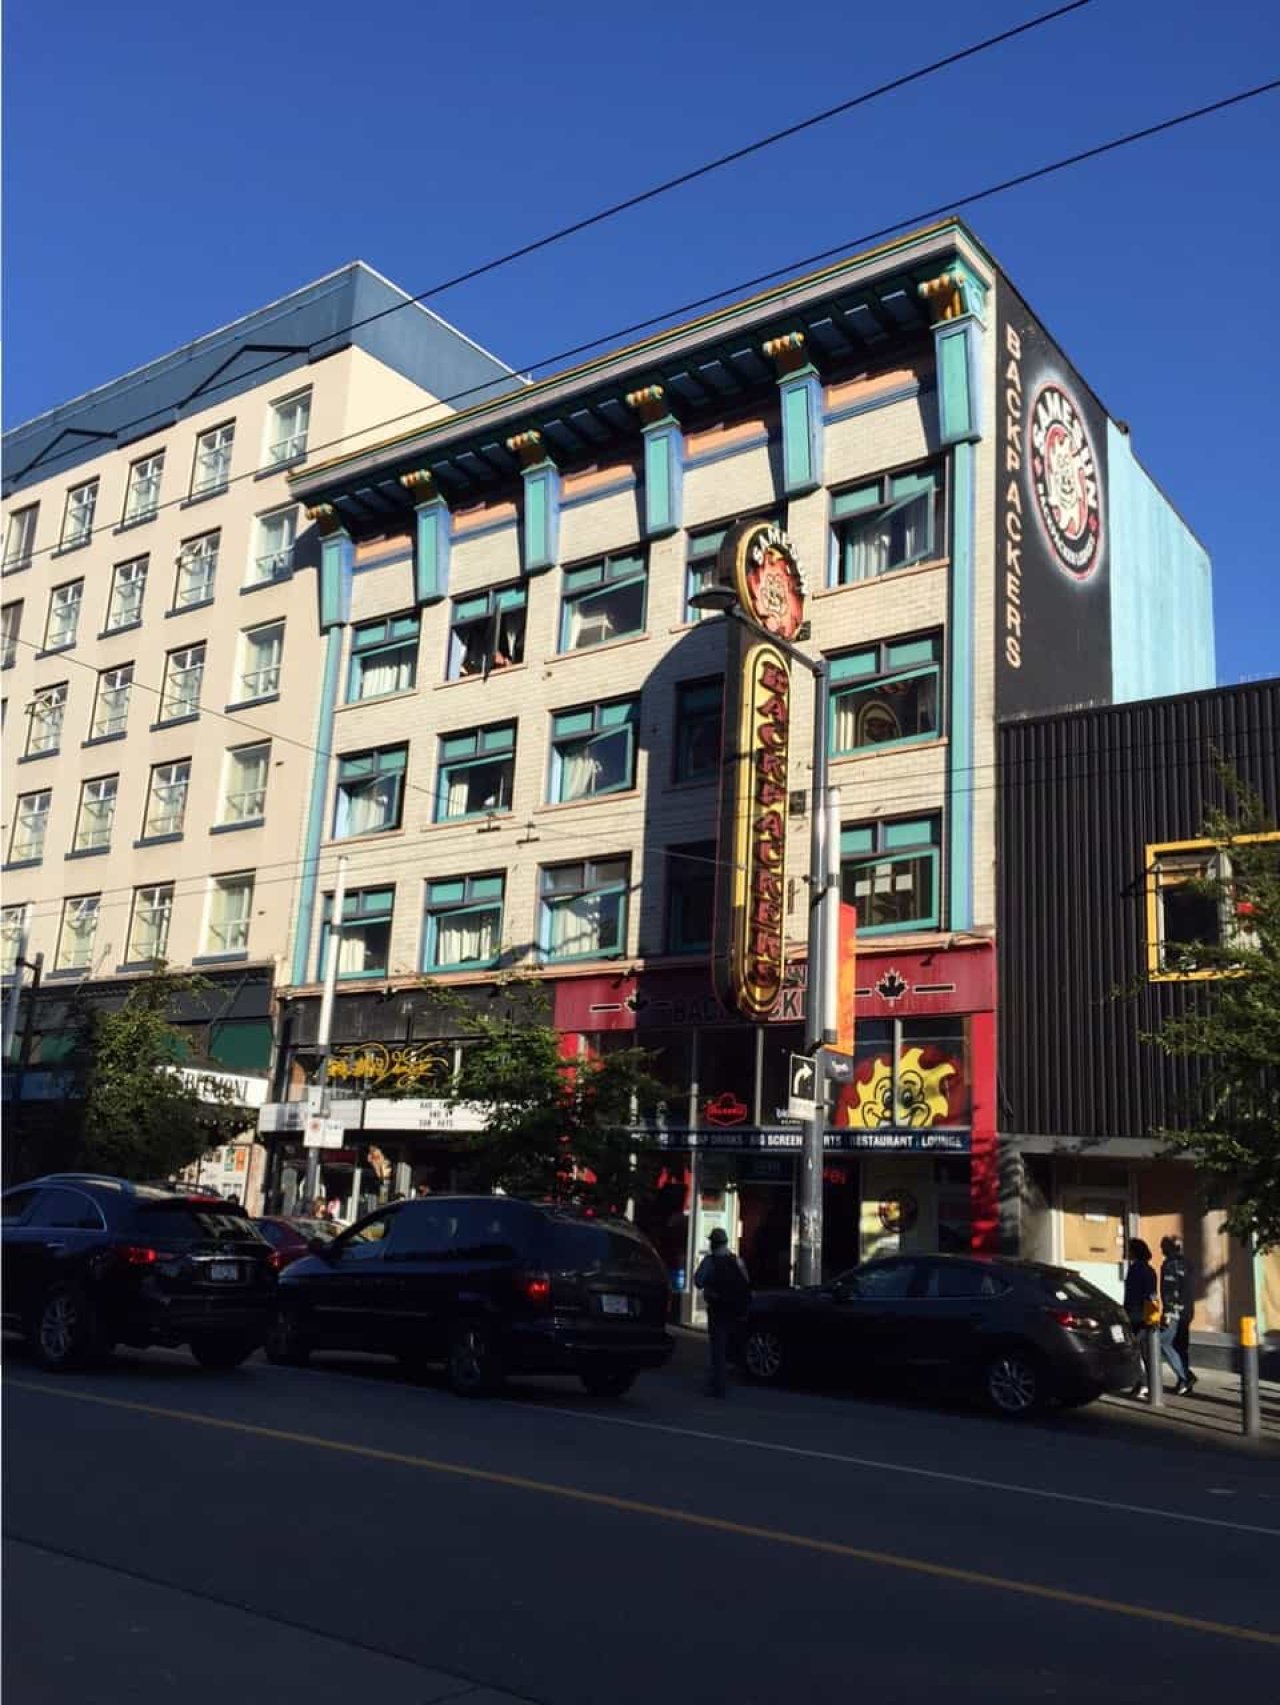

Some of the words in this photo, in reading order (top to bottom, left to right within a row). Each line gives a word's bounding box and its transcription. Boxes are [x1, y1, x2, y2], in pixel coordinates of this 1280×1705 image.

[1005, 323, 1023, 669] BACKPACKERS
[1033, 391, 1098, 508] SAMESUN
[749, 661, 790, 986] BACKPACKERS
[767, 1134, 803, 1147] SCREEN
[850, 1134, 913, 1147] RESTAURANT
[922, 1135, 963, 1148] LOUNGE
